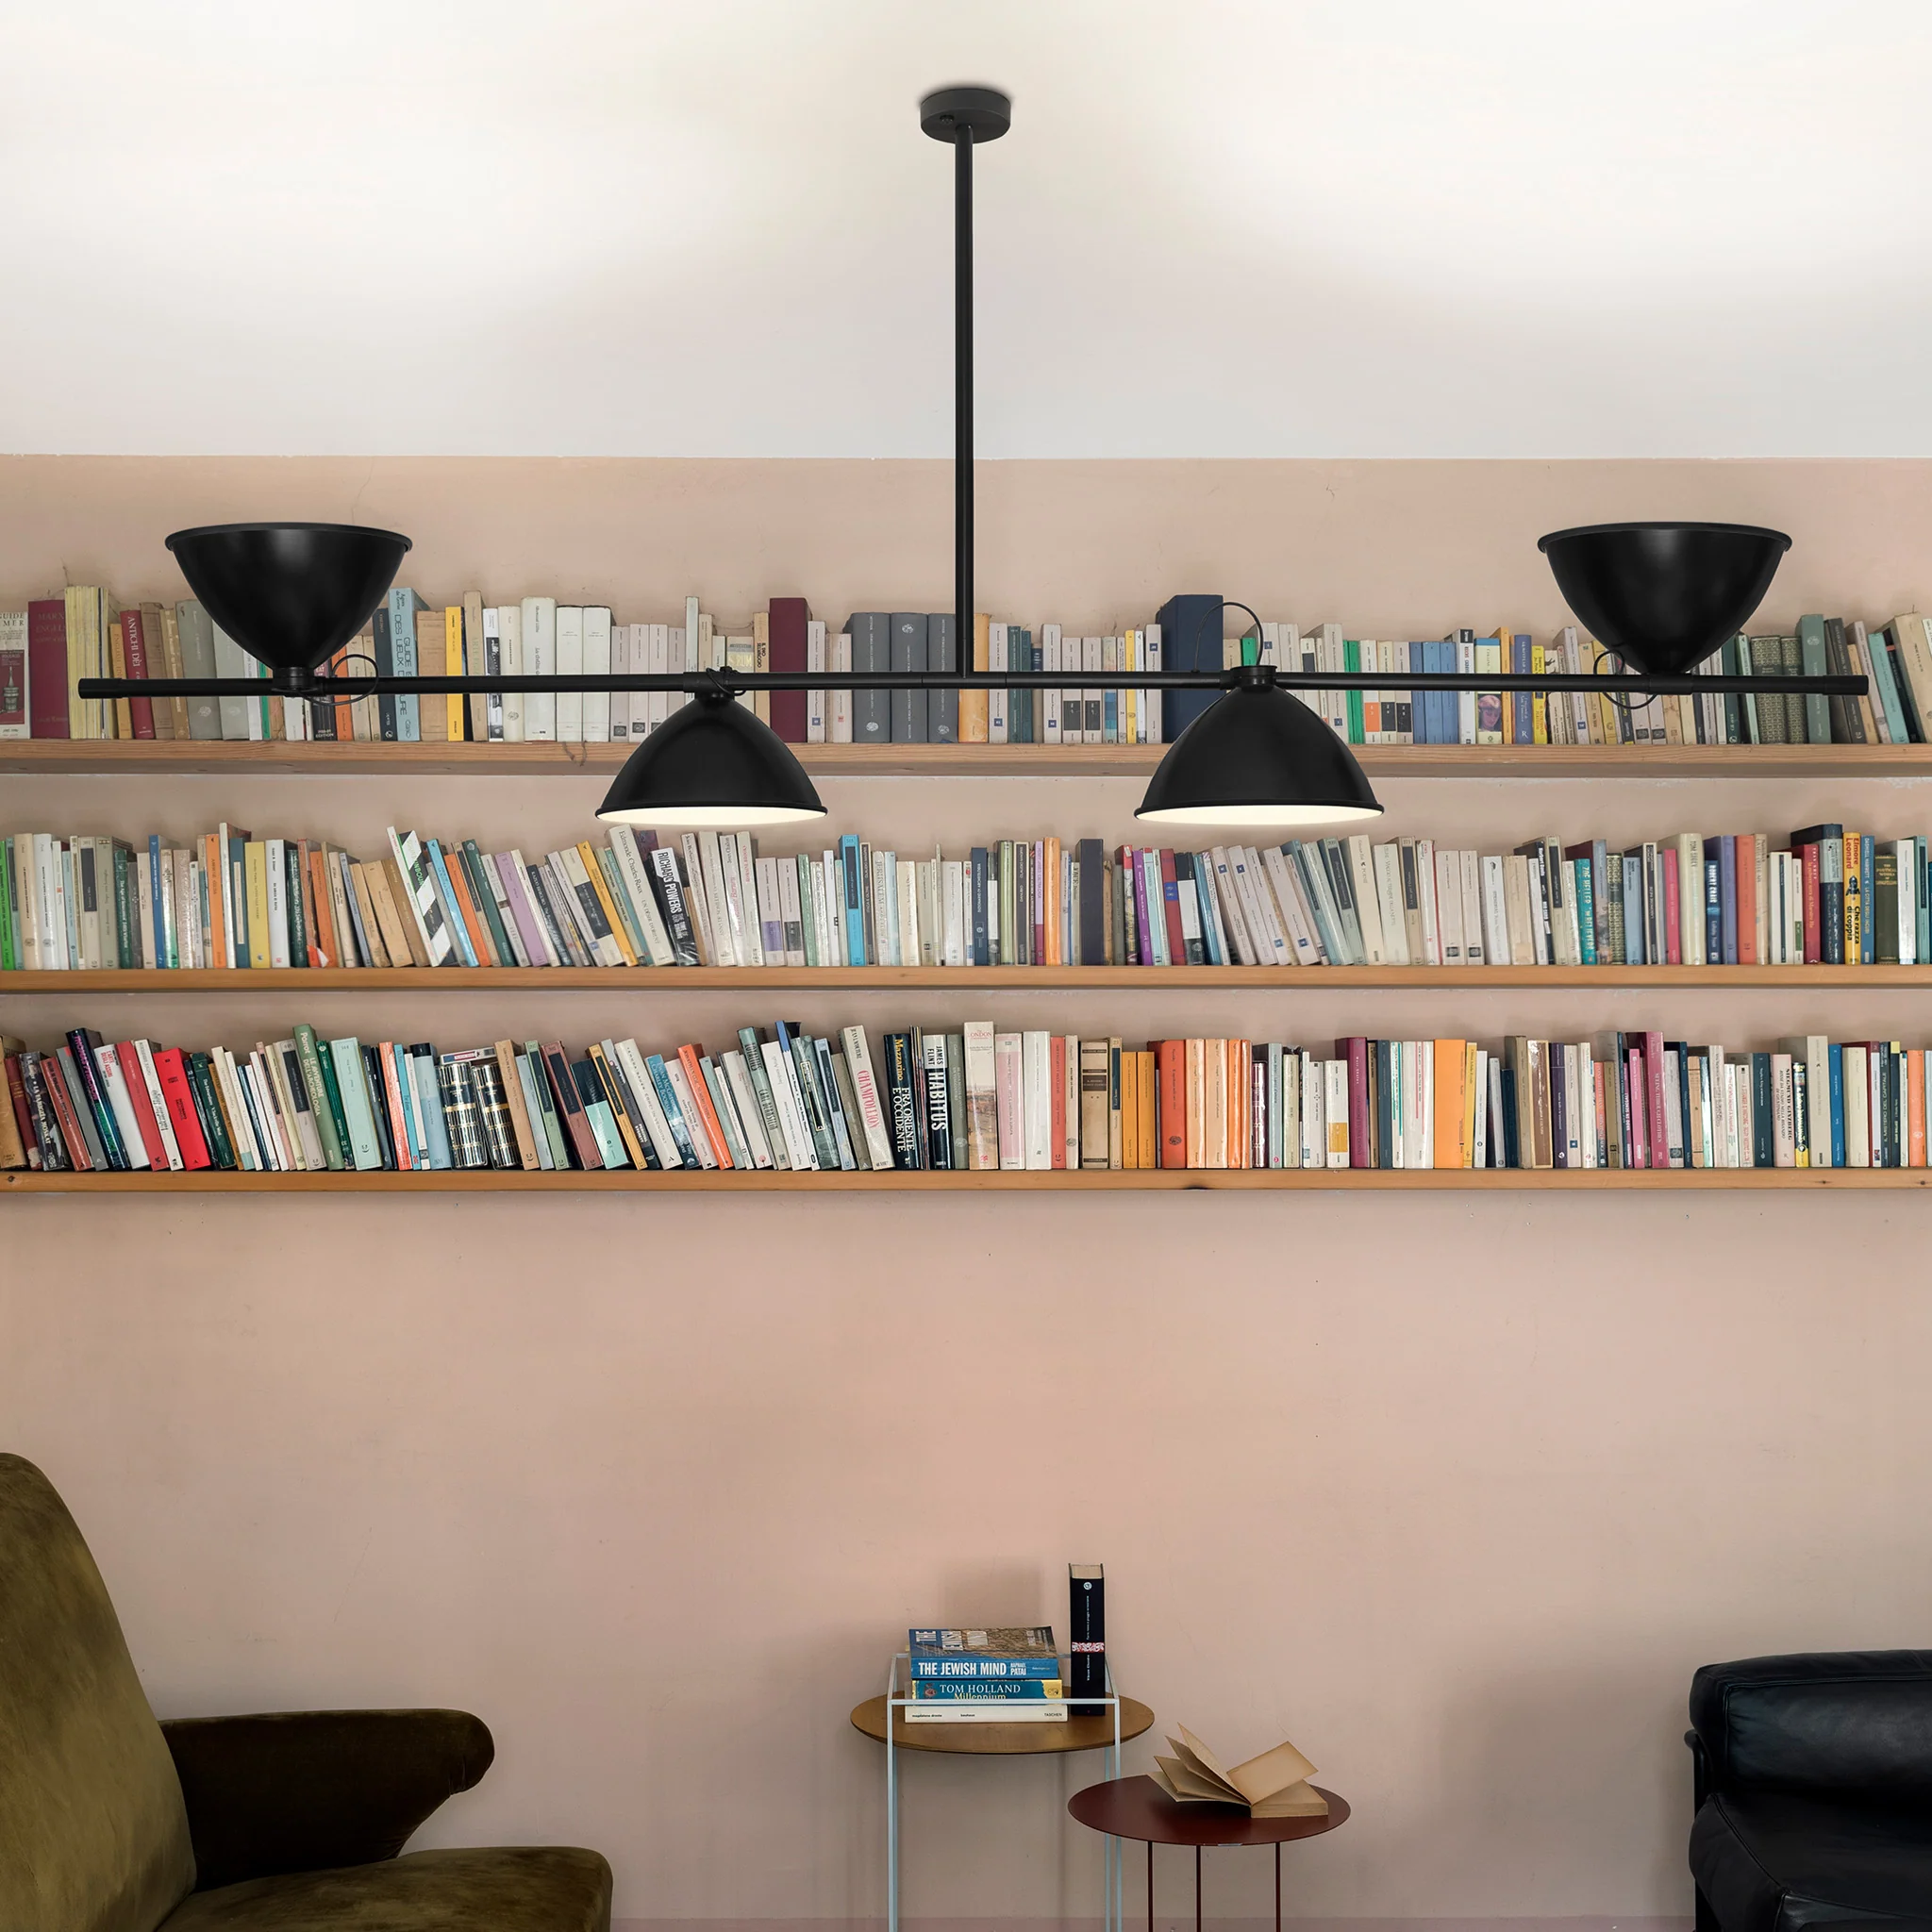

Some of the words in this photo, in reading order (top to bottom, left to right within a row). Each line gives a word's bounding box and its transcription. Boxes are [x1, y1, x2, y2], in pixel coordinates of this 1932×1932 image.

[126, 616, 139, 651] ANTICHI
[394, 614, 403, 635] DES
[395, 638, 405, 666] LIEUX
[403, 637, 412, 667] GUIDE
[618, 830, 632, 858] Edmonde
[657, 851, 675, 882] RICHARD
[1707, 864, 1717, 886] ROBERT
[663, 884, 682, 914] POWERS
[1846, 906, 1854, 915] di
[1845, 915, 1854, 941] coppia
[74, 1035, 88, 1065] THOMAS
[300, 1031, 310, 1054] Parrot
[935, 1045, 943, 1065] JAMES
[308, 1057, 317, 1065] LE
[893, 1039, 906, 1081] Mazzarino
[926, 1048, 935, 1067] FLINT
[302, 1058, 321, 1117] DELL'ARCHEOLOGIA
[856, 1070, 880, 1129] CHAMPOLLION
[891, 1087, 900, 1095] E
[901, 1087, 911, 1108] FRA
[927, 1071, 947, 1132] HABITUS
[33, 1085, 42, 1094] LA
[40, 1121, 52, 1145] MOSKAT
[892, 1095, 907, 1153] OCCIDENTE
[902, 1108, 915, 1152] ORIENTE
[919, 1662, 938, 1675] THE
[941, 1662, 976, 1675] JEWISH
[980, 1662, 1007, 1675] MIND
[1010, 1667, 1026, 1675] PATAI
[940, 1684, 964, 1693] TOM
[968, 1684, 1021, 1693] HOLLAND
